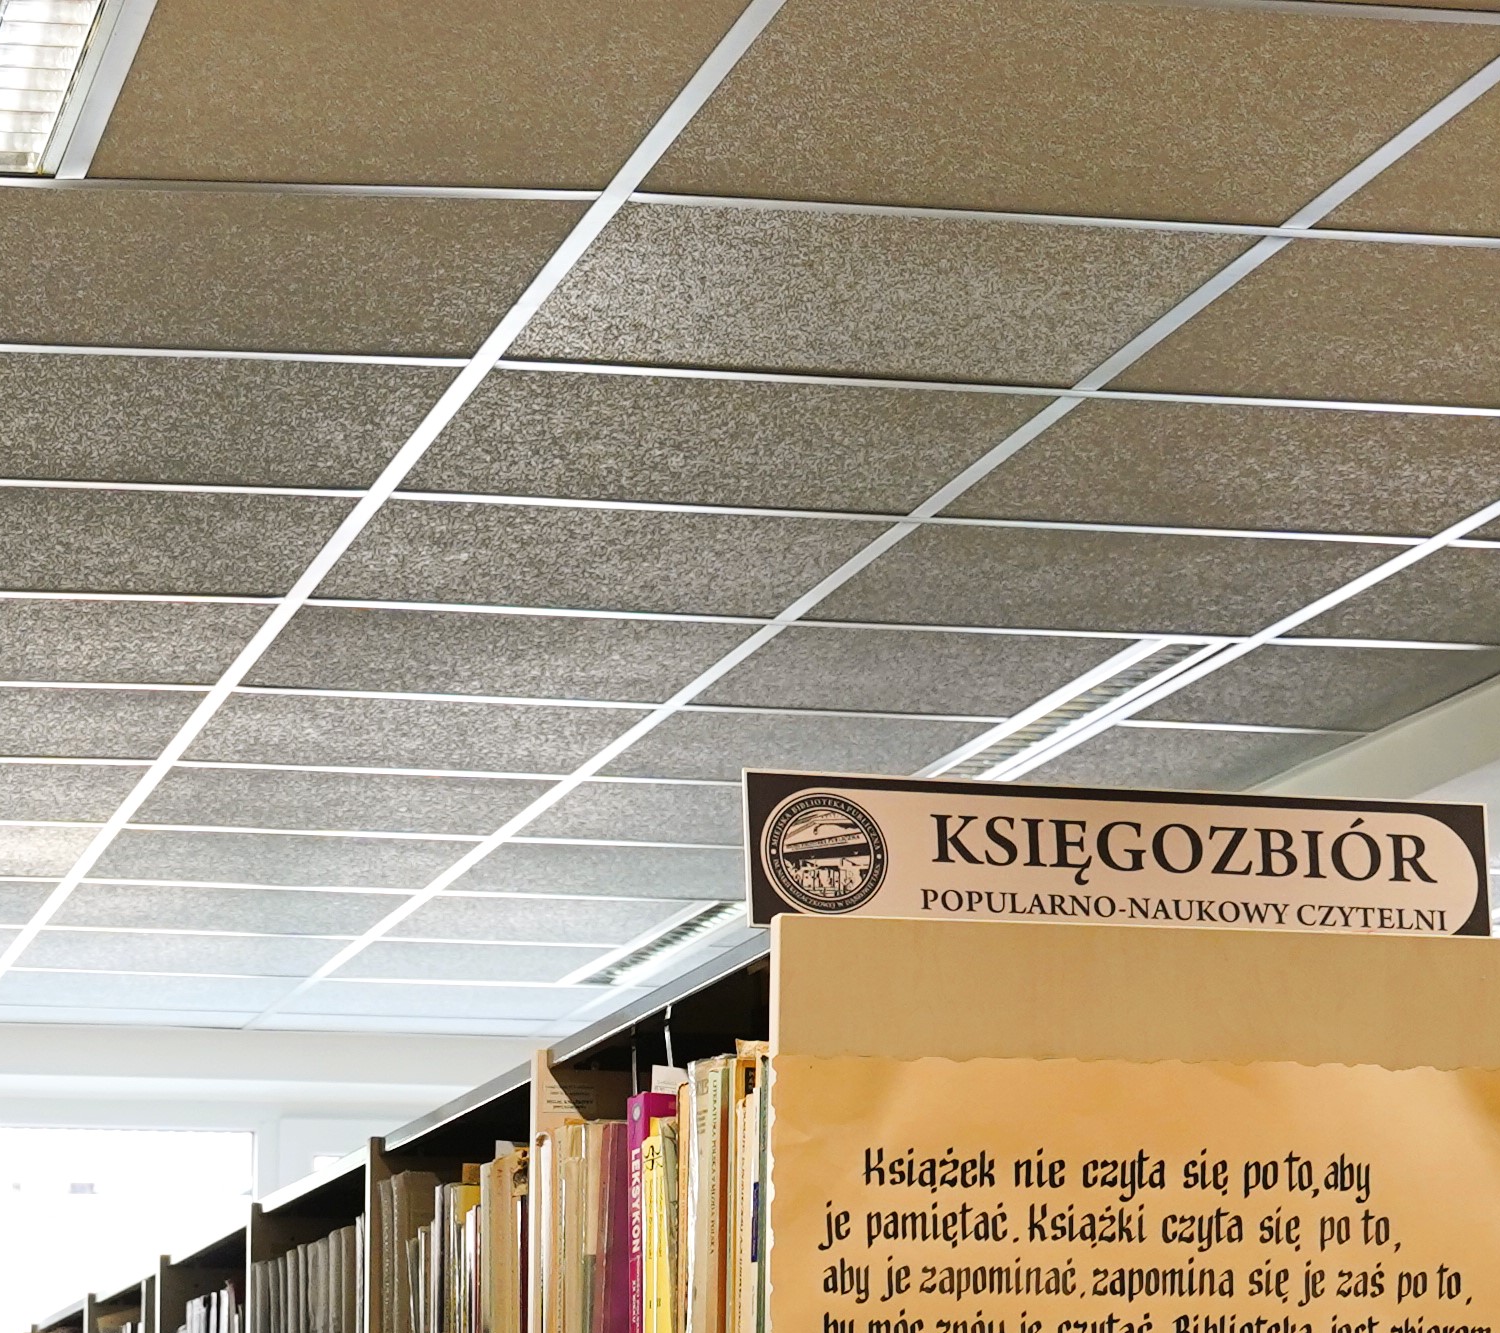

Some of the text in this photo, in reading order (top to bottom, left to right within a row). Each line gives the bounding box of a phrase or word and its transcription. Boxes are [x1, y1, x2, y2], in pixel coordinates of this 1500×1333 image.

[931, 812, 1438, 888] KSIĘGOZBIÓR
[920, 887, 1449, 932] POPULARNO-NAUKOWY CZYTELNI
[630, 1147, 643, 1253] LEKSYKON
[863, 1147, 996, 1194] Książek
[1014, 1147, 1066, 1189] nie
[1082, 1148, 1166, 1203] czyta
[1183, 1148, 1229, 1197] się
